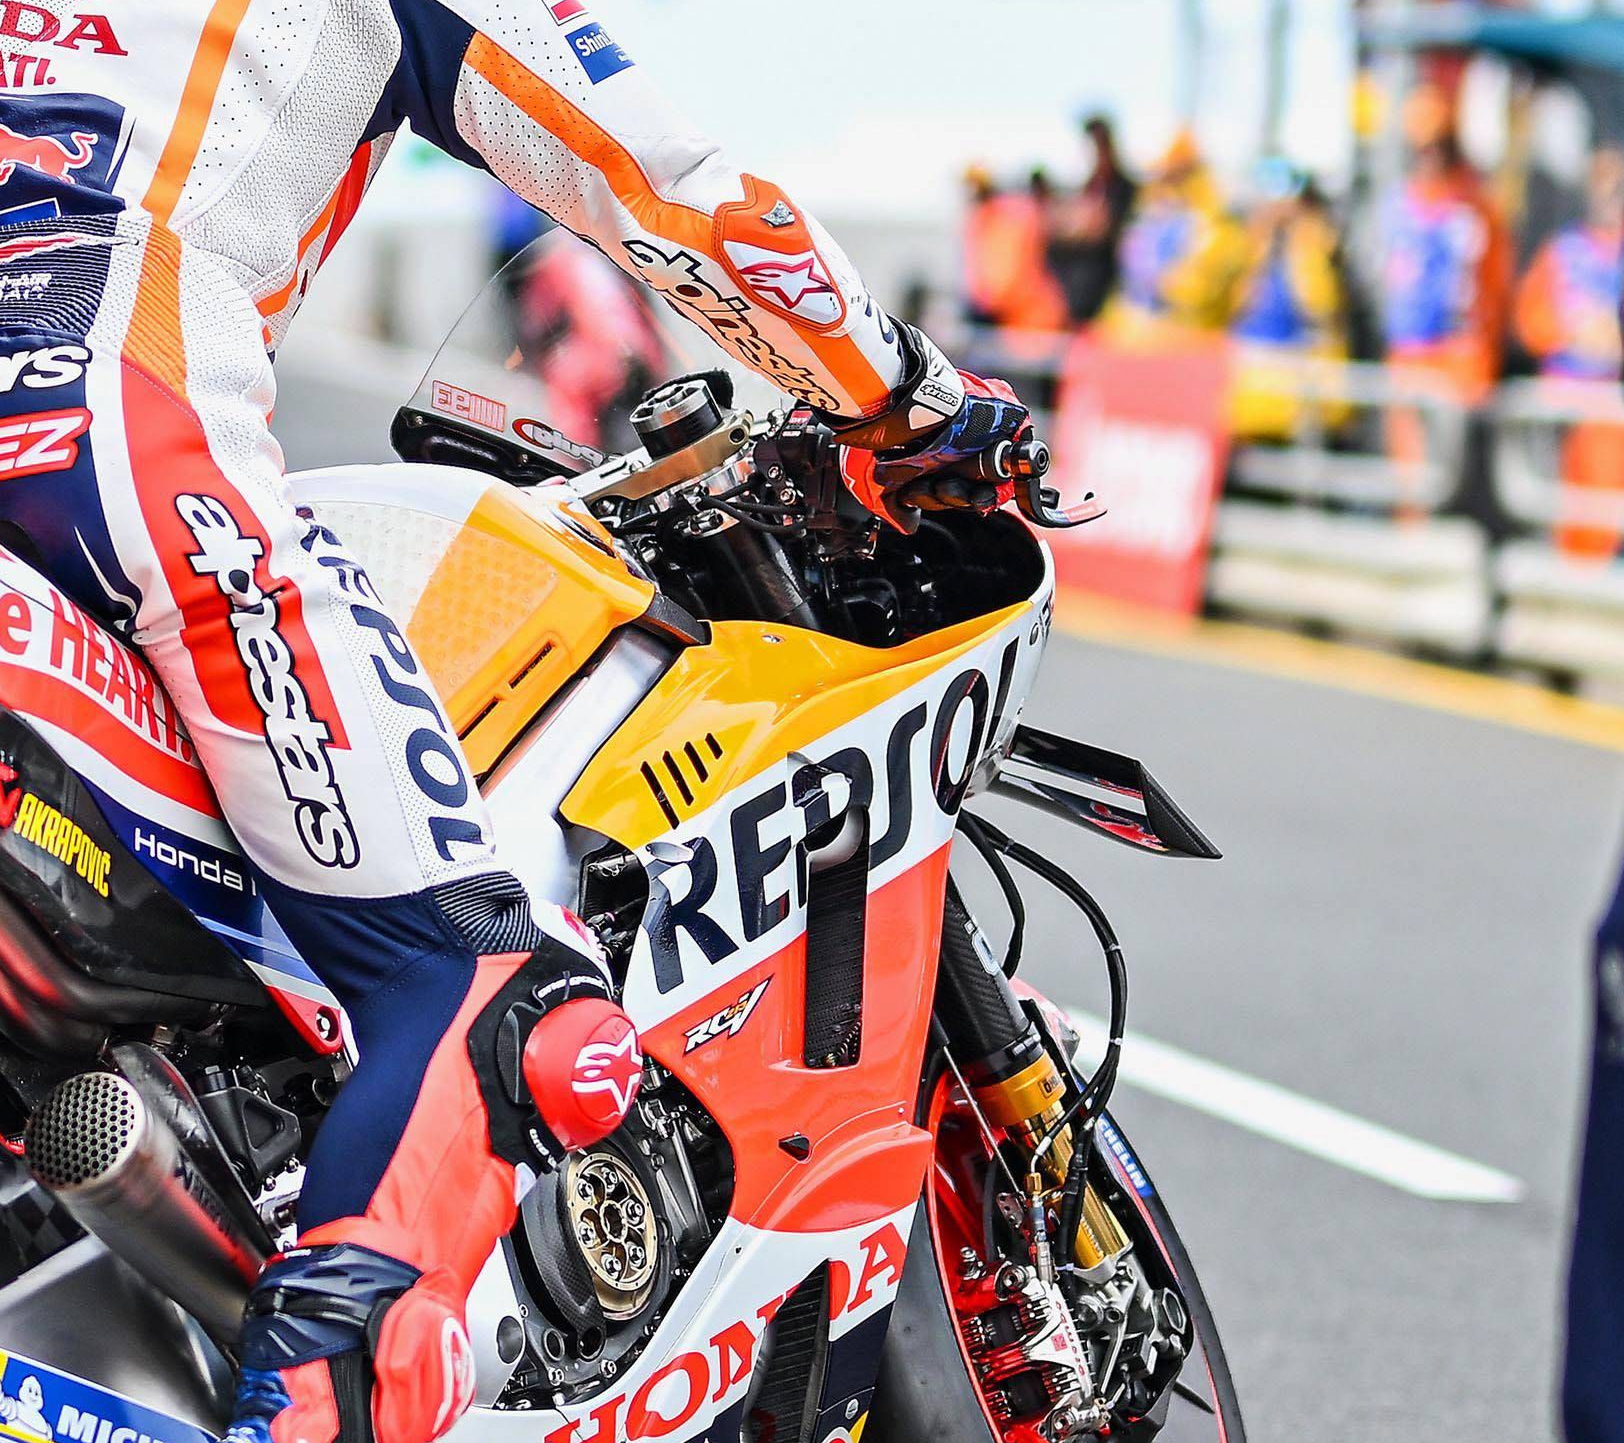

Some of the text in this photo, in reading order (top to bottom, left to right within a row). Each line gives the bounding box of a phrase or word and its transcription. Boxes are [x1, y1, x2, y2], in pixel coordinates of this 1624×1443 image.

[173, 493, 361, 869] alpnestars
[134, 827, 243, 891] Honda
[641, 634, 1020, 996] REPSOL
[1097, 1116, 1147, 1190] CHELIN
